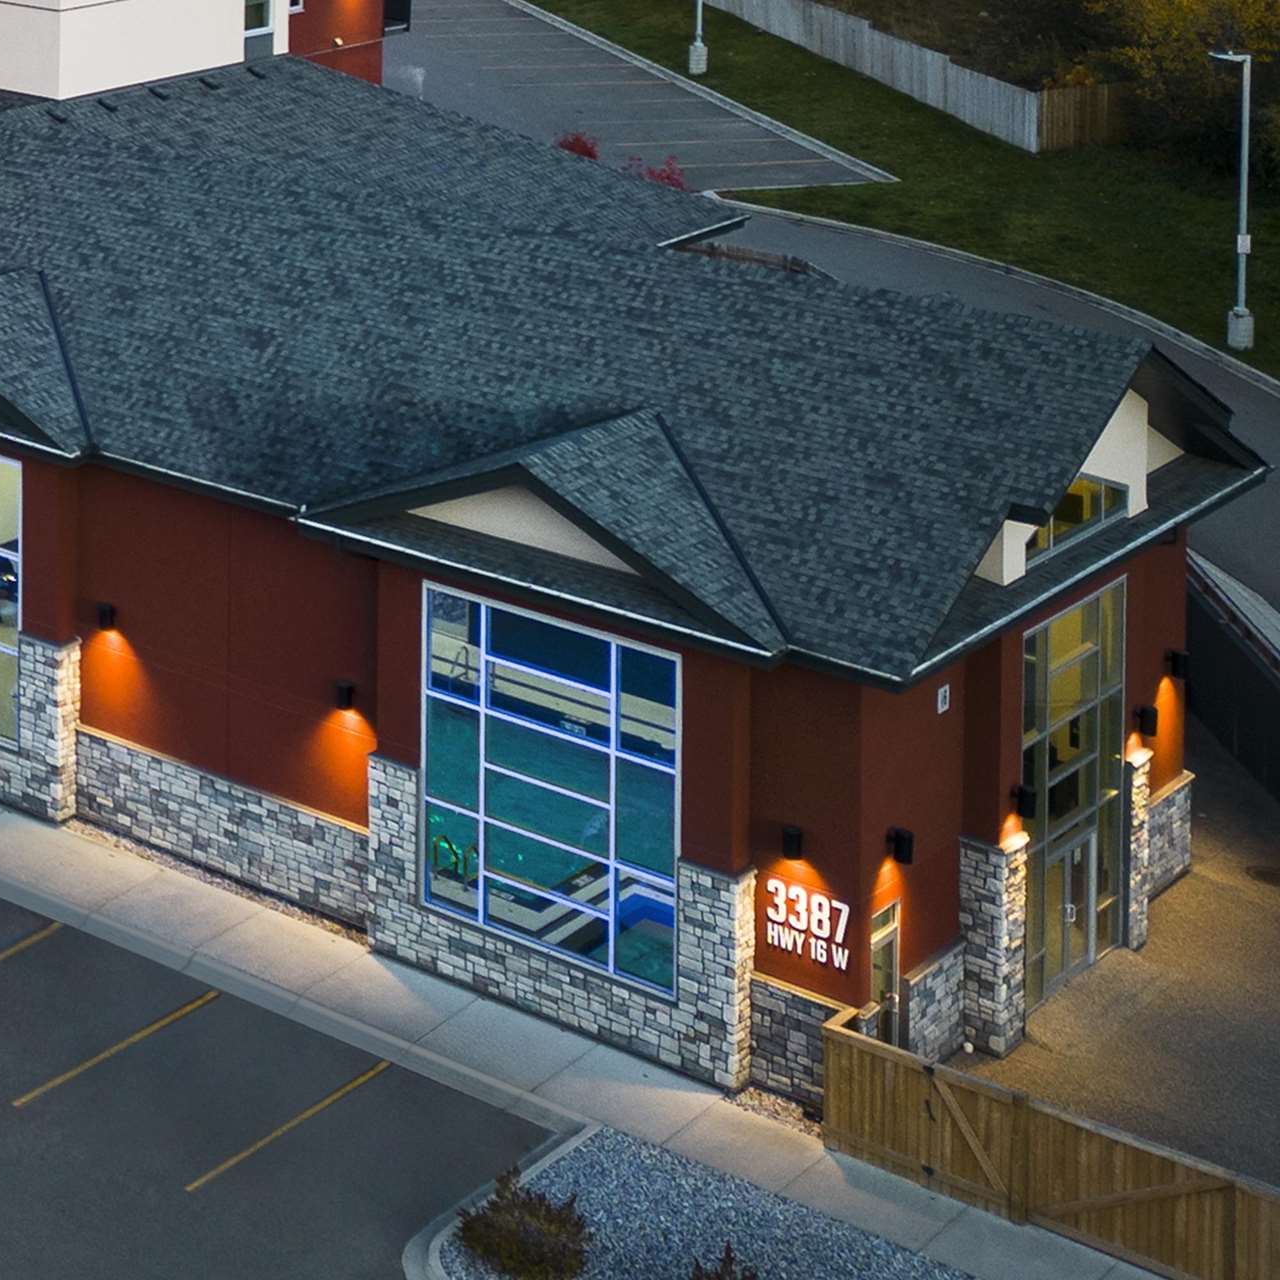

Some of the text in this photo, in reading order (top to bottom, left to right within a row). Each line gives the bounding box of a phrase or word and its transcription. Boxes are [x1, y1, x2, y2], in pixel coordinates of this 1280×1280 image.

[766, 878, 850, 944] 3387
[767, 922, 850, 971] HWY 16 W
